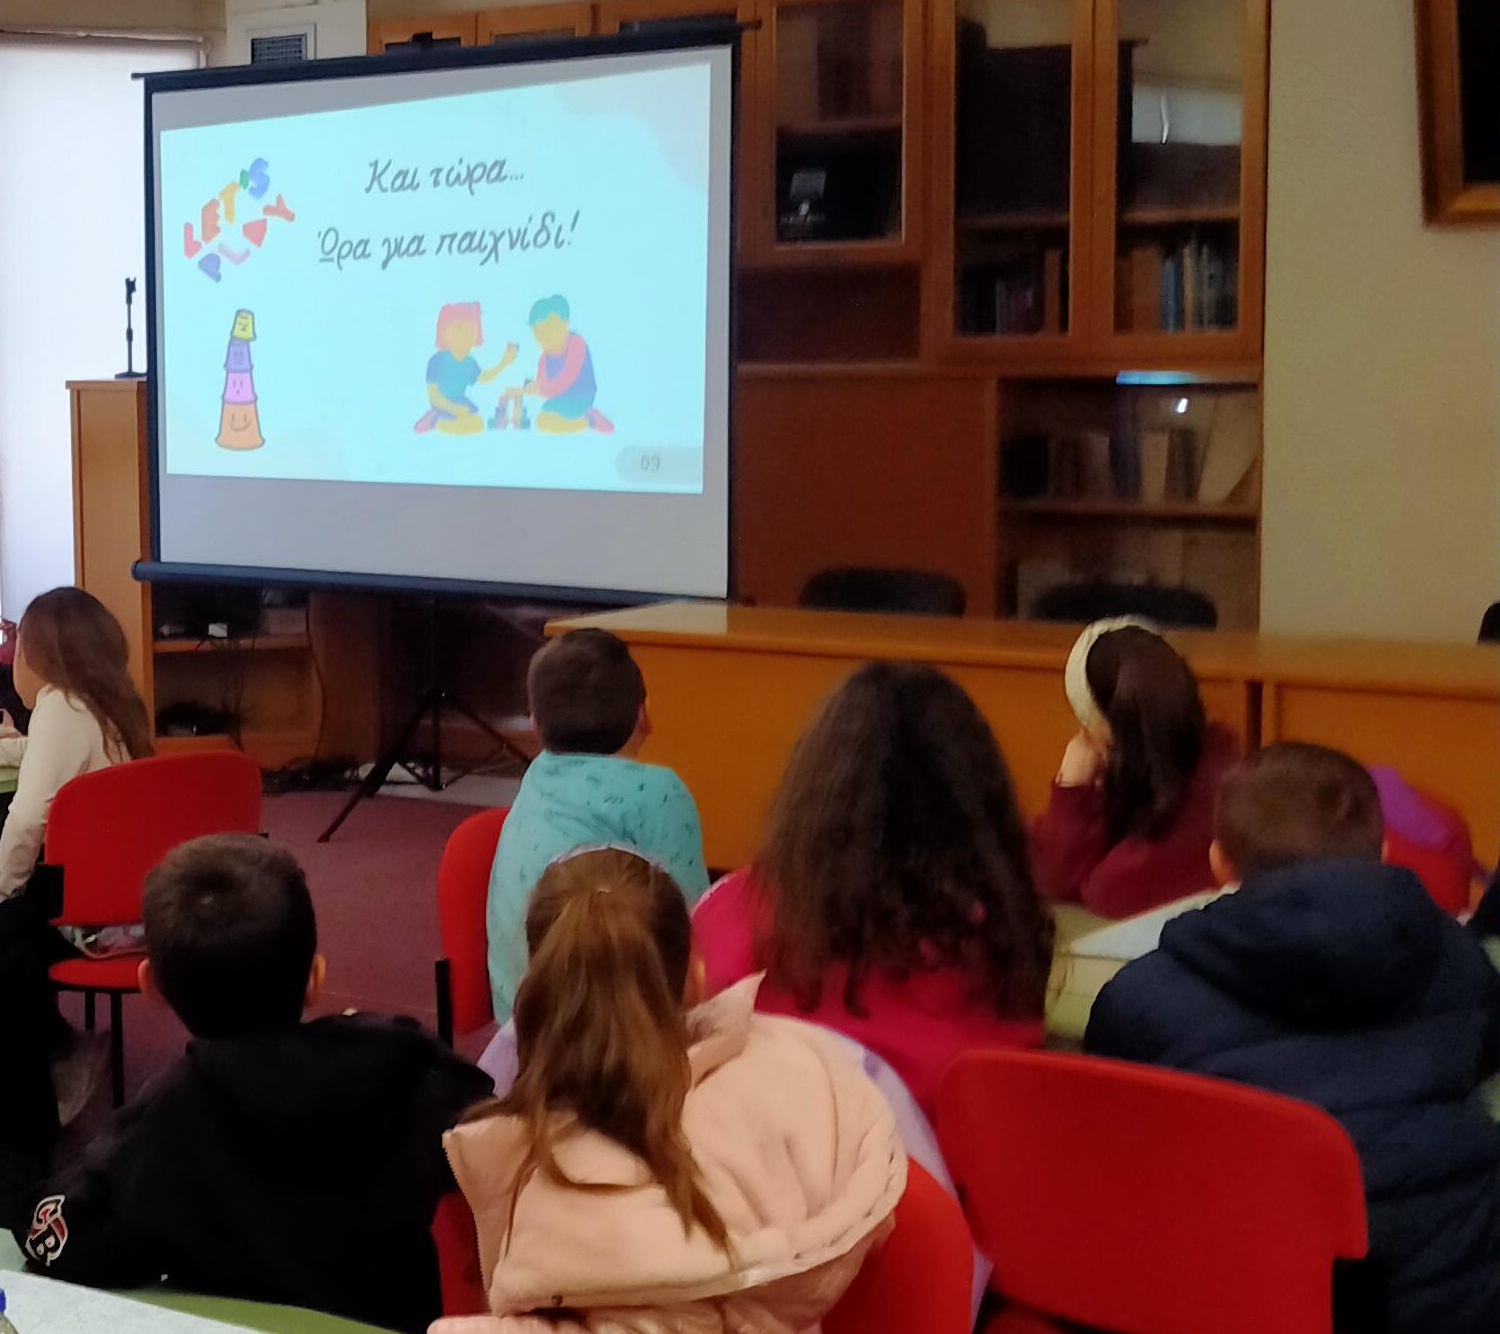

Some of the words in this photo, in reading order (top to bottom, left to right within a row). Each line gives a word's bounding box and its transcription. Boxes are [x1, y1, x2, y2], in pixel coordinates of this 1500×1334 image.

[364, 158, 420, 194] Και
[429, 156, 524, 196] τώρα...
[317, 226, 371, 271] Ώρα
[381, 233, 426, 270] για
[435, 209, 580, 266] παιχνίδι!
